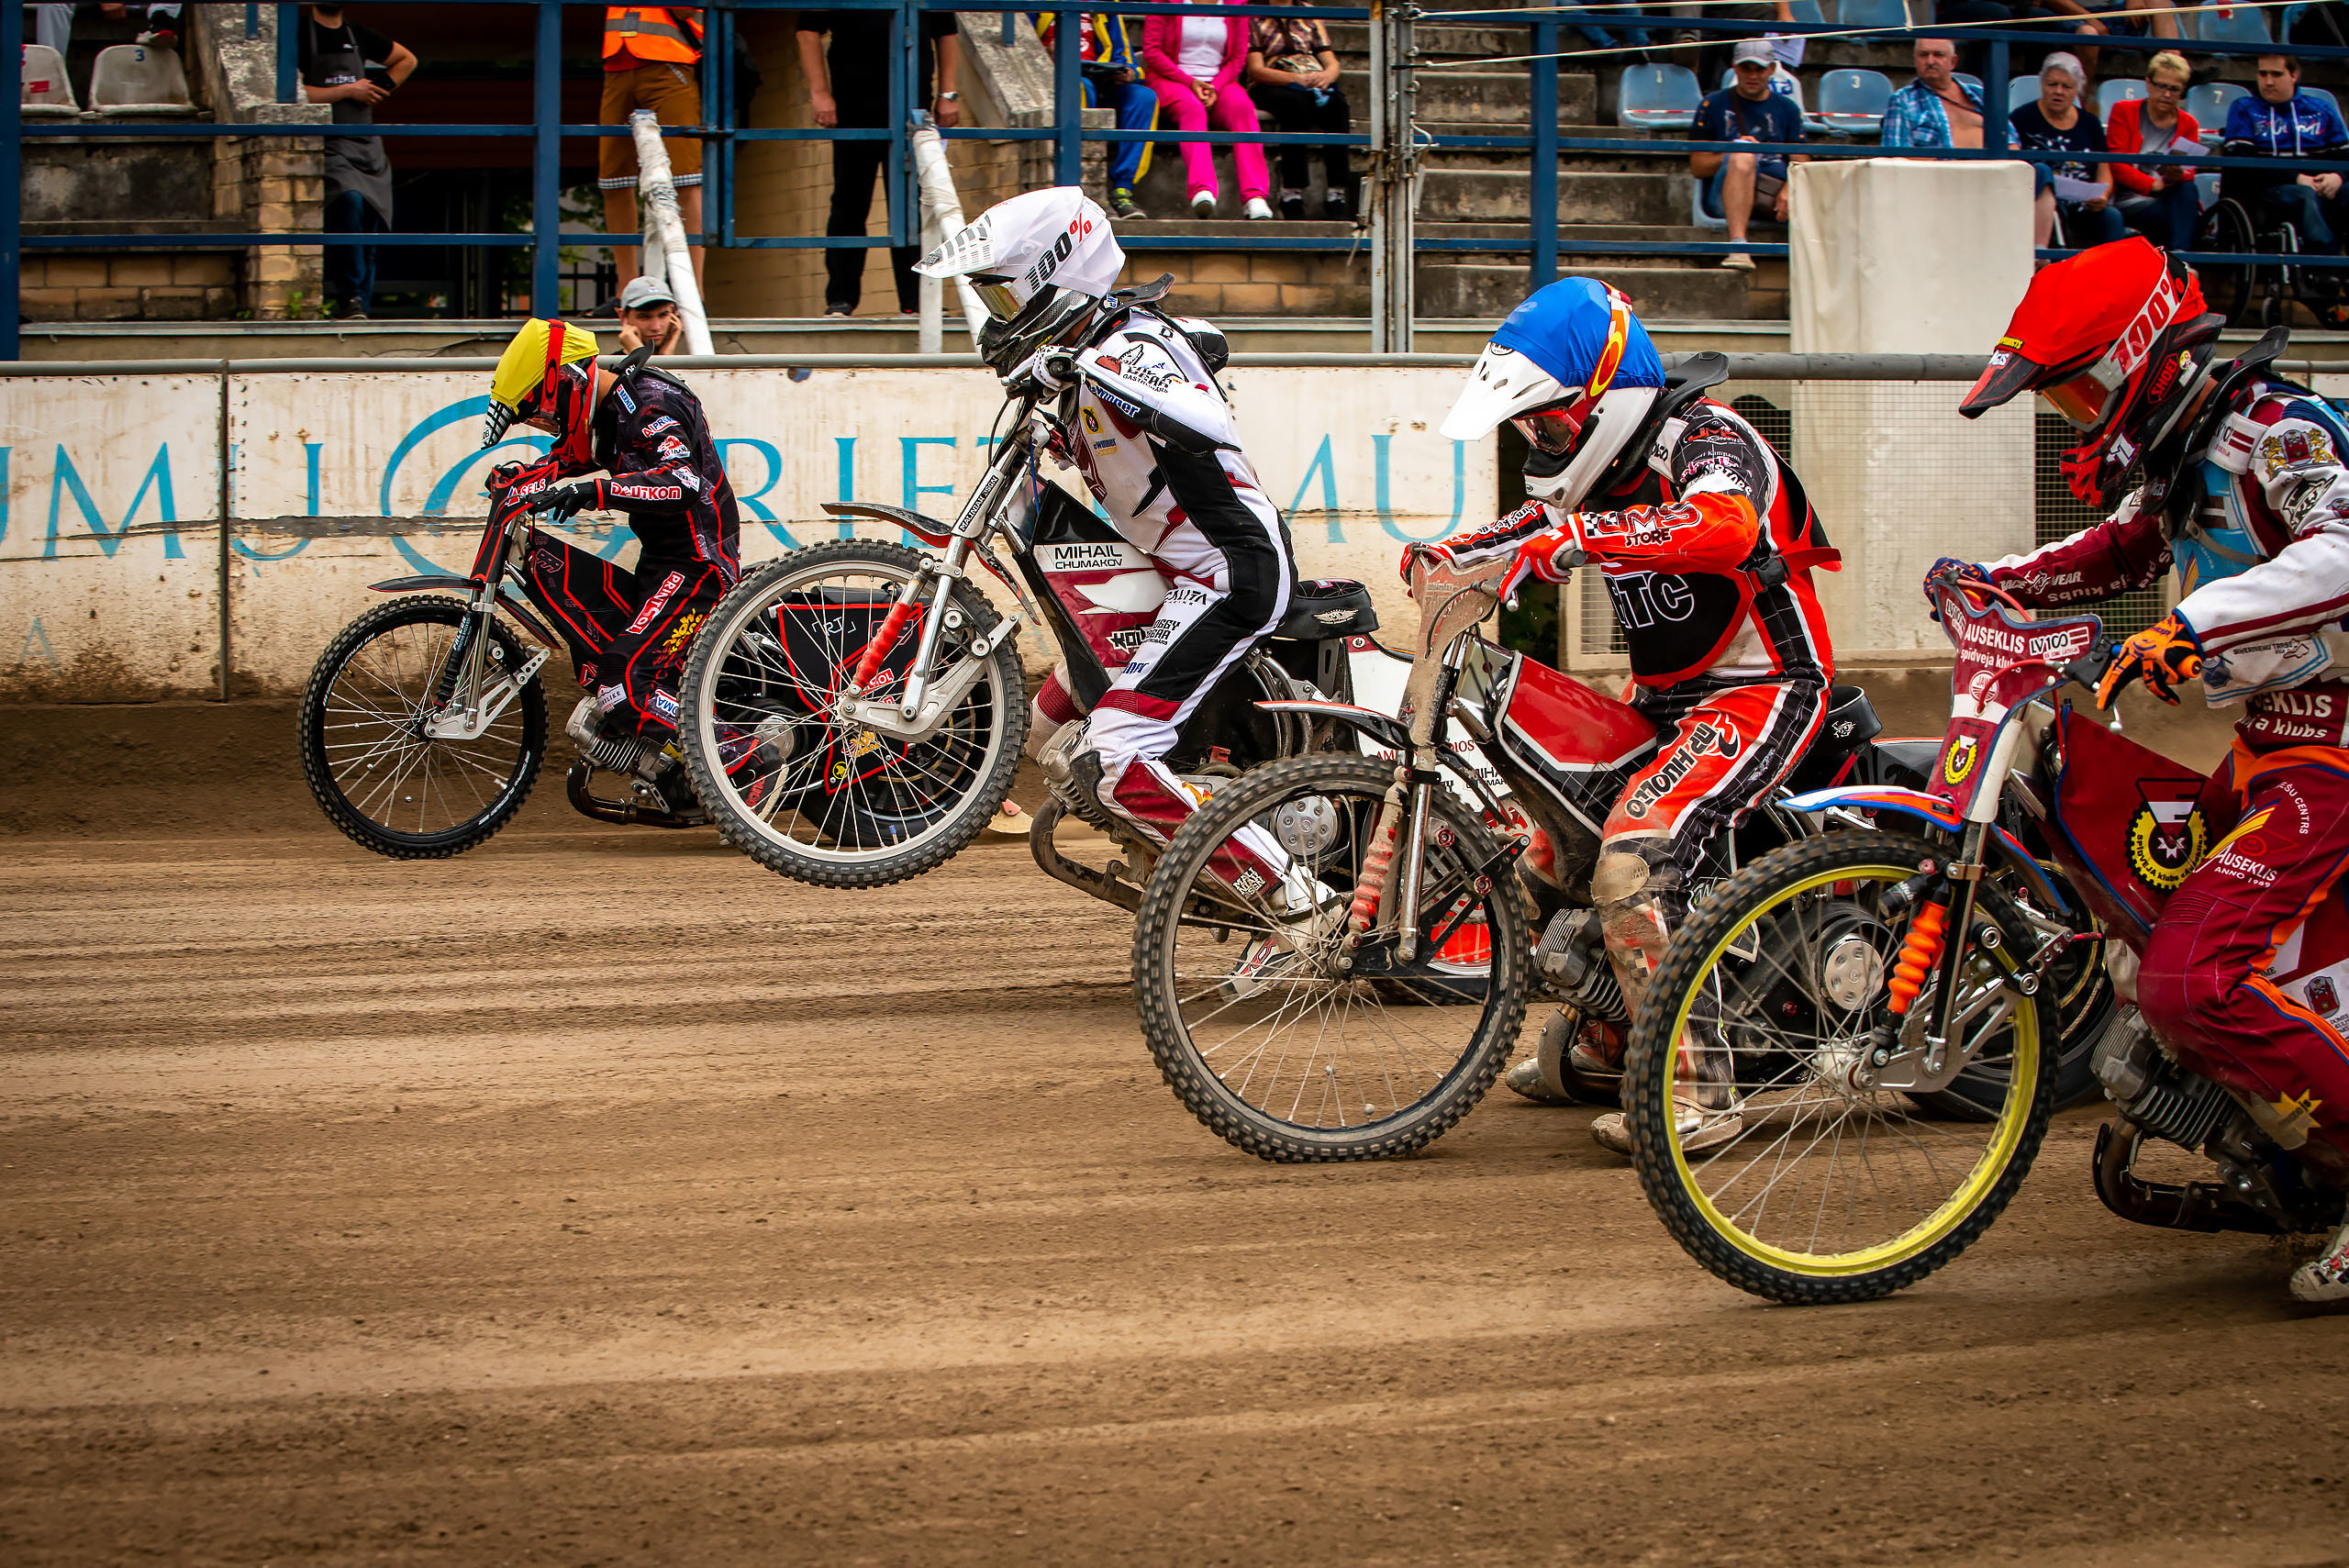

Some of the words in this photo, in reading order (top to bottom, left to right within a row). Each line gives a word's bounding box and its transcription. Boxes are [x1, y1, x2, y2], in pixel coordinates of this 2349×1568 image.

[134, 49, 145, 61] 3
[1851, 74, 1860, 88] 3
[2213, 90, 2223, 103] 7
[1024, 212, 1093, 294] 100%
[2110, 276, 2186, 375] 100%
[2151, 358, 2179, 403] SHOEI
[619, 389, 636, 413] BERNER
[958, 495, 985, 532] MALINIAK
[1625, 528, 1672, 547] STORE
[1054, 545, 1122, 560] MIHAIL
[1054, 559, 1123, 570] CHUMAKOV
[452, 616, 468, 651] FALCON
[1965, 623, 2025, 654] AUSEKLIS
[2272, 718, 2328, 739] klubs
[2294, 796, 2310, 835] CENTRS
[2206, 841, 2278, 883] AUSEKLIS
[2156, 871, 2180, 882] klubs
[2214, 865, 2246, 881] ANNO
[2247, 876, 2272, 889] 1989
